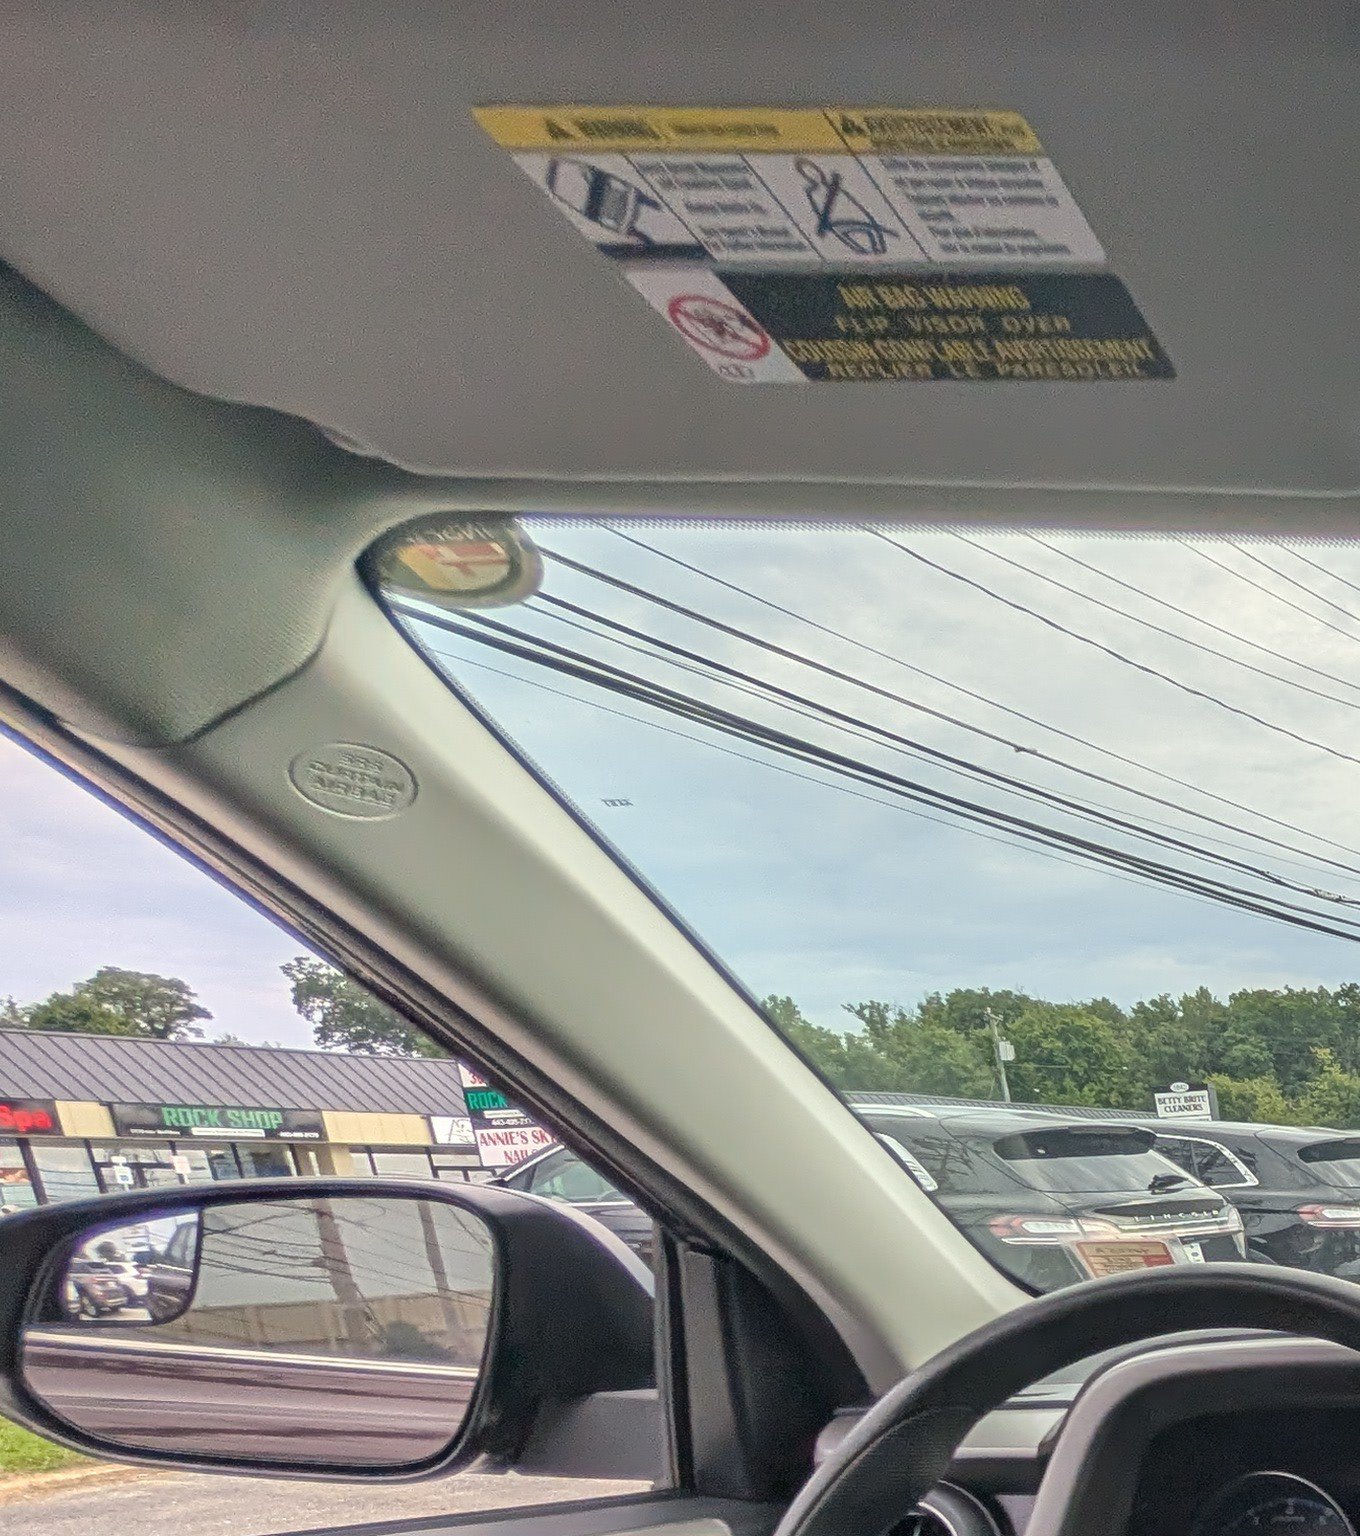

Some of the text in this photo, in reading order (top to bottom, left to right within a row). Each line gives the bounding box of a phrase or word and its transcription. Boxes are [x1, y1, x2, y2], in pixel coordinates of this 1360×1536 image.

[835, 314, 1072, 334] FLIP VISOR OVER
[1164, 1104, 1204, 1113] CLEANERS
[161, 1107, 284, 1130] ROCK SHOP
[480, 1131, 528, 1147] ANNIE'S
